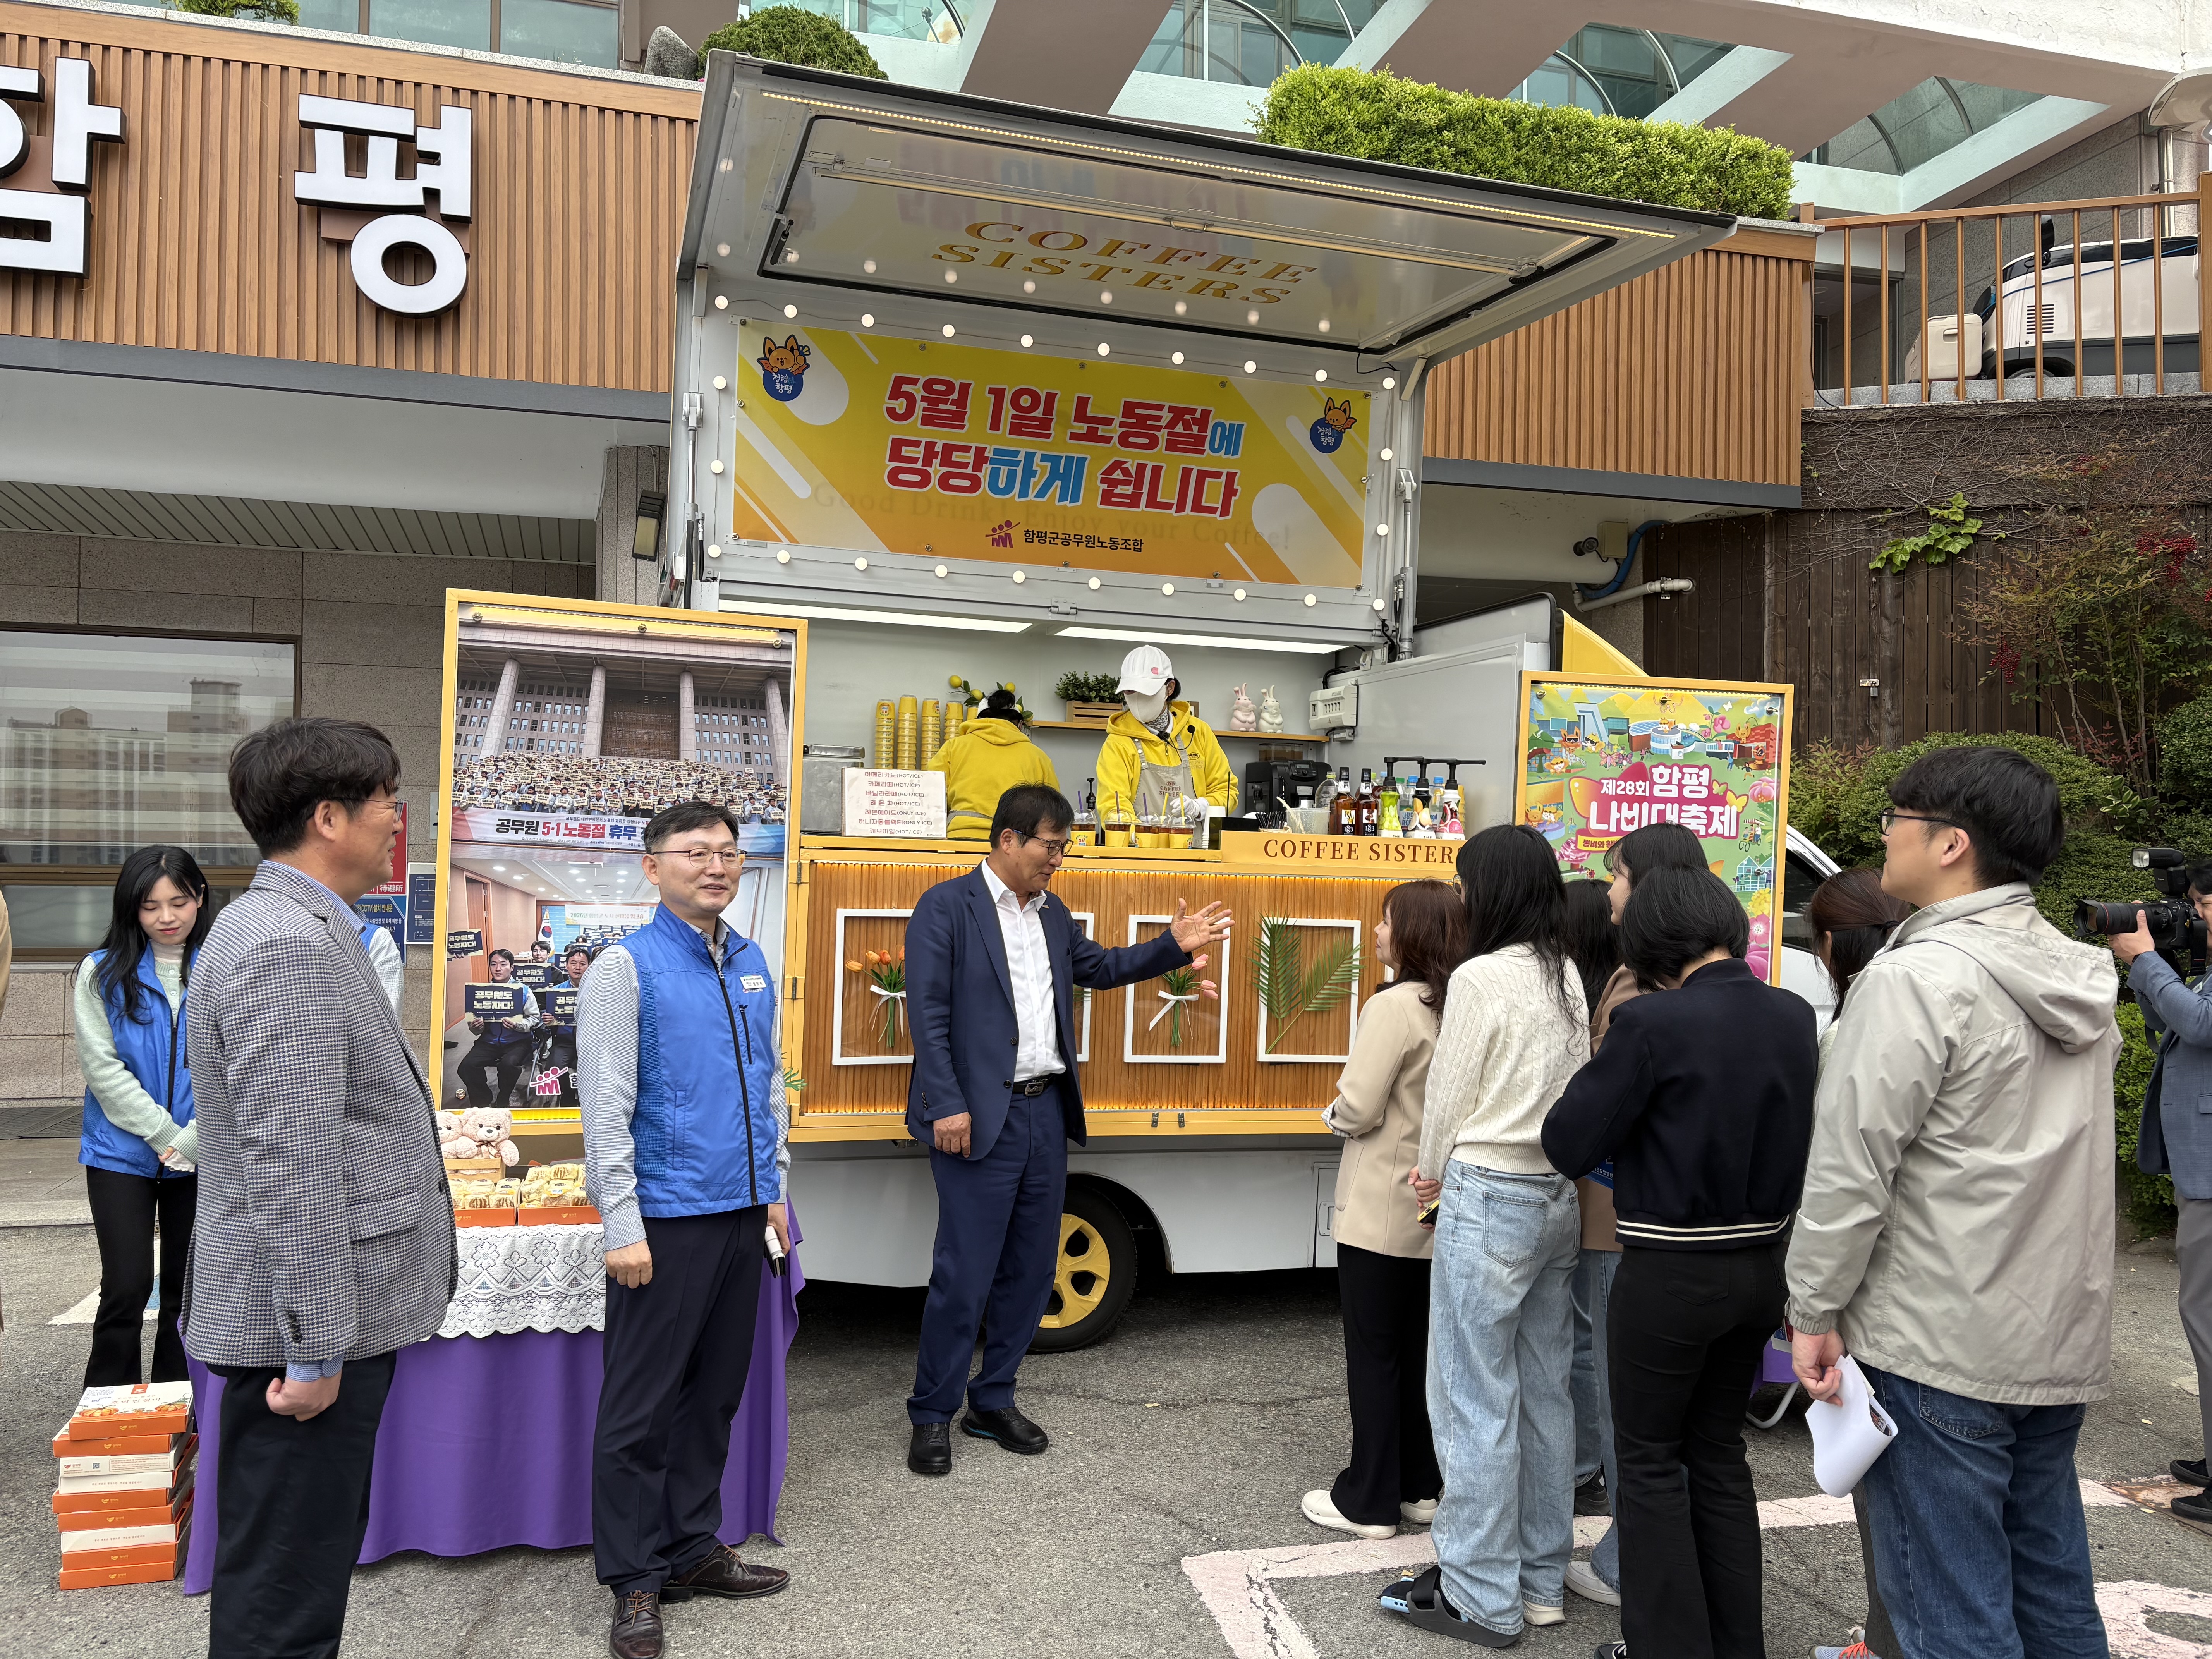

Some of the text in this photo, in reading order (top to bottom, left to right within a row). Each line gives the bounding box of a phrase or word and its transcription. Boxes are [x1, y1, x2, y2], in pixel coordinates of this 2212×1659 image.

[965, 222, 1317, 283] COFFEE
[931, 243, 1292, 304] SISTERS
[772, 372, 788, 383] 청렴
[775, 383, 792, 394] 함평
[885, 374, 1244, 458] 5월 1일 노동절에
[885, 436, 1240, 519] 당당하게 쉽니다
[814, 483, 895, 517] Good
[1023, 528, 1144, 553] 함평군공무원노동조합
[1600, 764, 1710, 799] 제28회 함평
[496, 818, 538, 835] 공무원
[563, 823, 606, 839] 노동절
[609, 824, 637, 840] 휴무
[1589, 800, 1738, 837] 나비대축제
[1264, 839, 1462, 864] COFFEE SISTER
[448, 934, 475, 942] 공무원도
[448, 941, 477, 949] 노동자다!
[473, 1001, 514, 1010] 노동자다!
[475, 991, 513, 1000] 공무원도
[556, 996, 577, 1005] 공무
[555, 1006, 575, 1014] 노동
